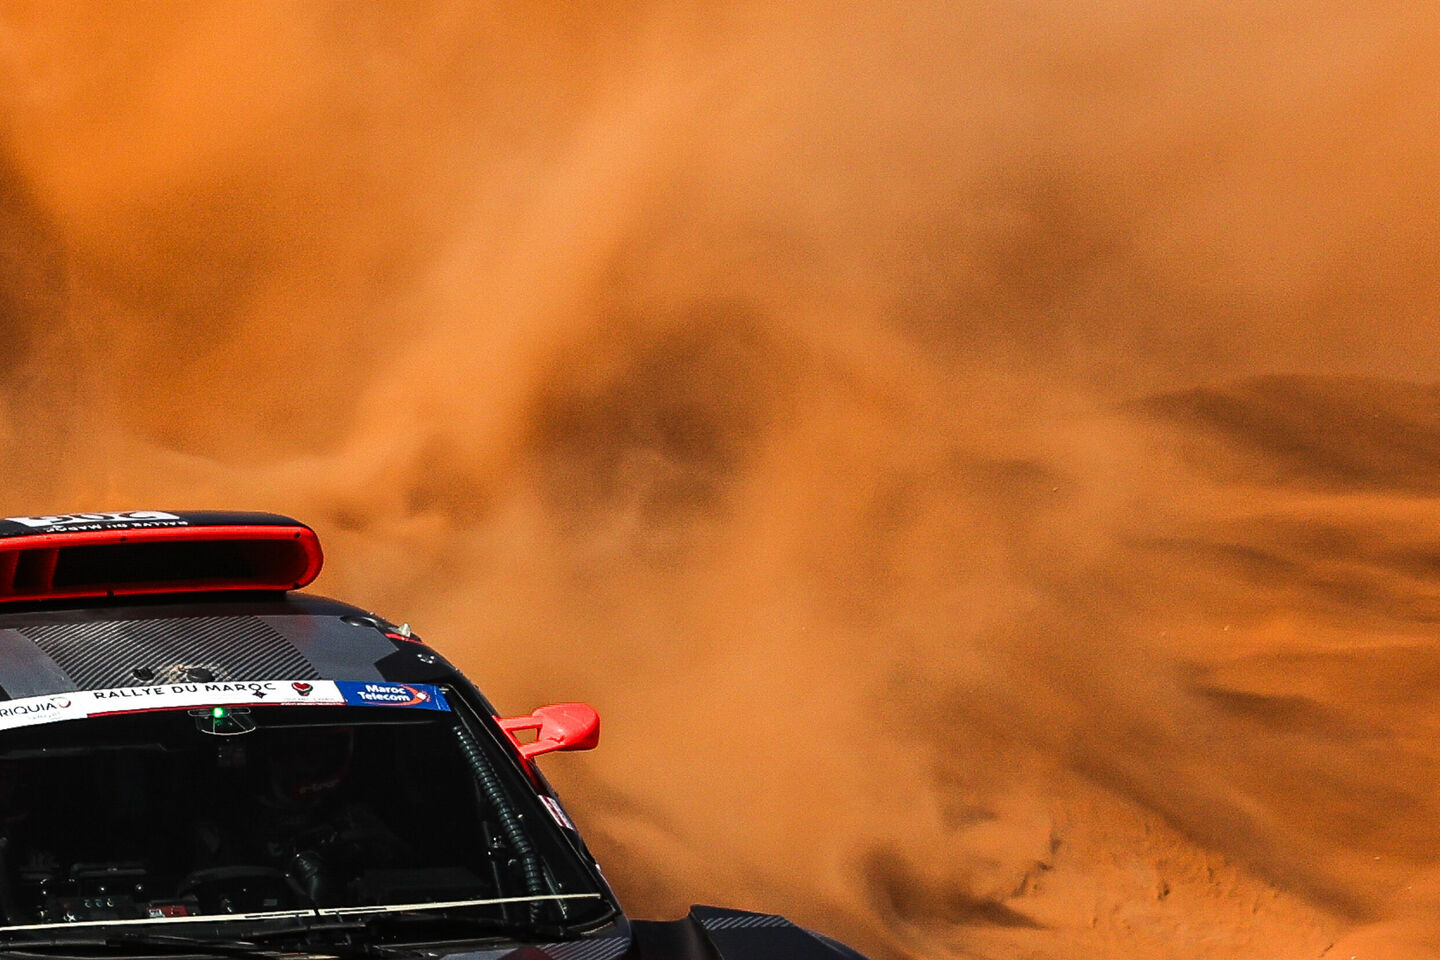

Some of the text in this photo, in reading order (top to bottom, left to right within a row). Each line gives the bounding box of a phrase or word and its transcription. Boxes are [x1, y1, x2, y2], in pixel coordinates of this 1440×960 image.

[93, 683, 276, 700] RALLYE DU MAROC
[364, 684, 406, 694] Maroc
[357, 691, 411, 702] Telecom
